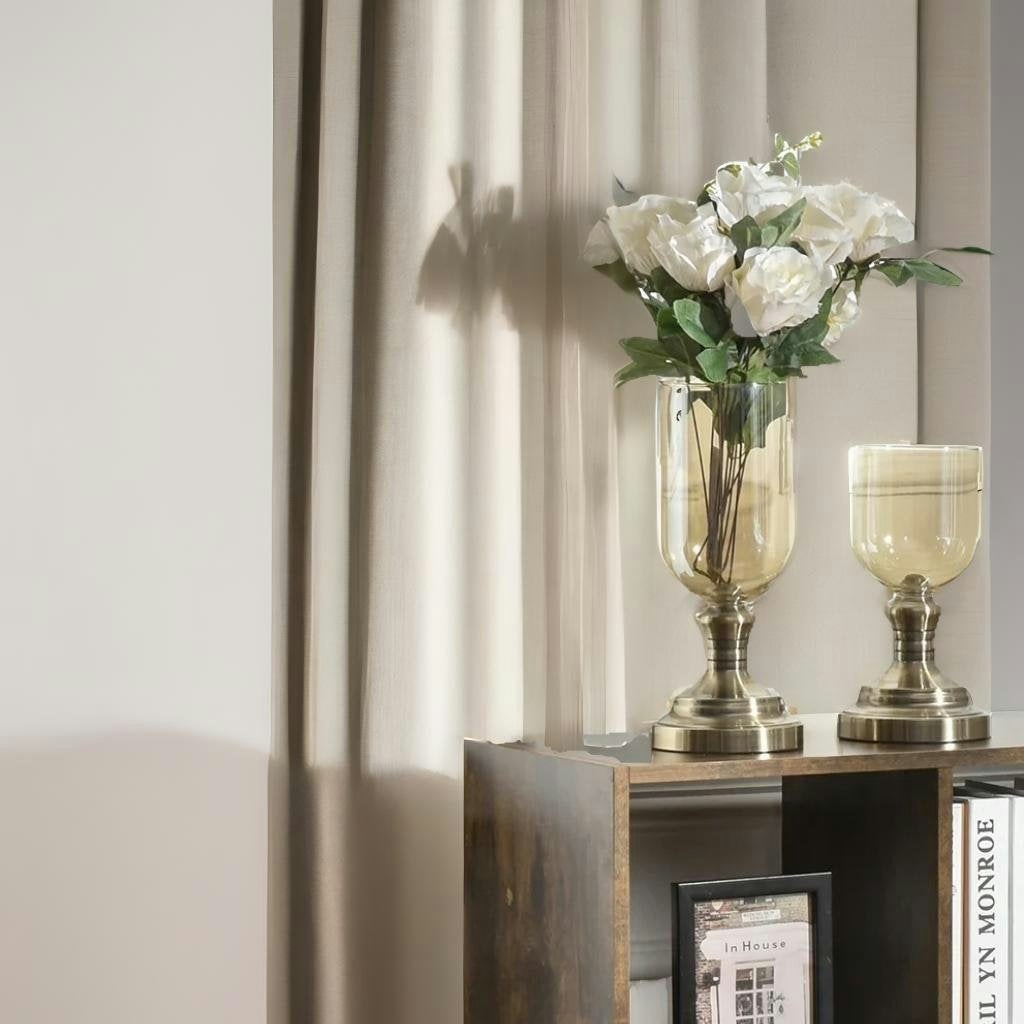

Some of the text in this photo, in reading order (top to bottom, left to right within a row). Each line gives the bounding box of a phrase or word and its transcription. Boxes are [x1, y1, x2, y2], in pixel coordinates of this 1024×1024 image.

[977, 818, 996, 935] MONROE
[725, 940, 787, 953] In House
